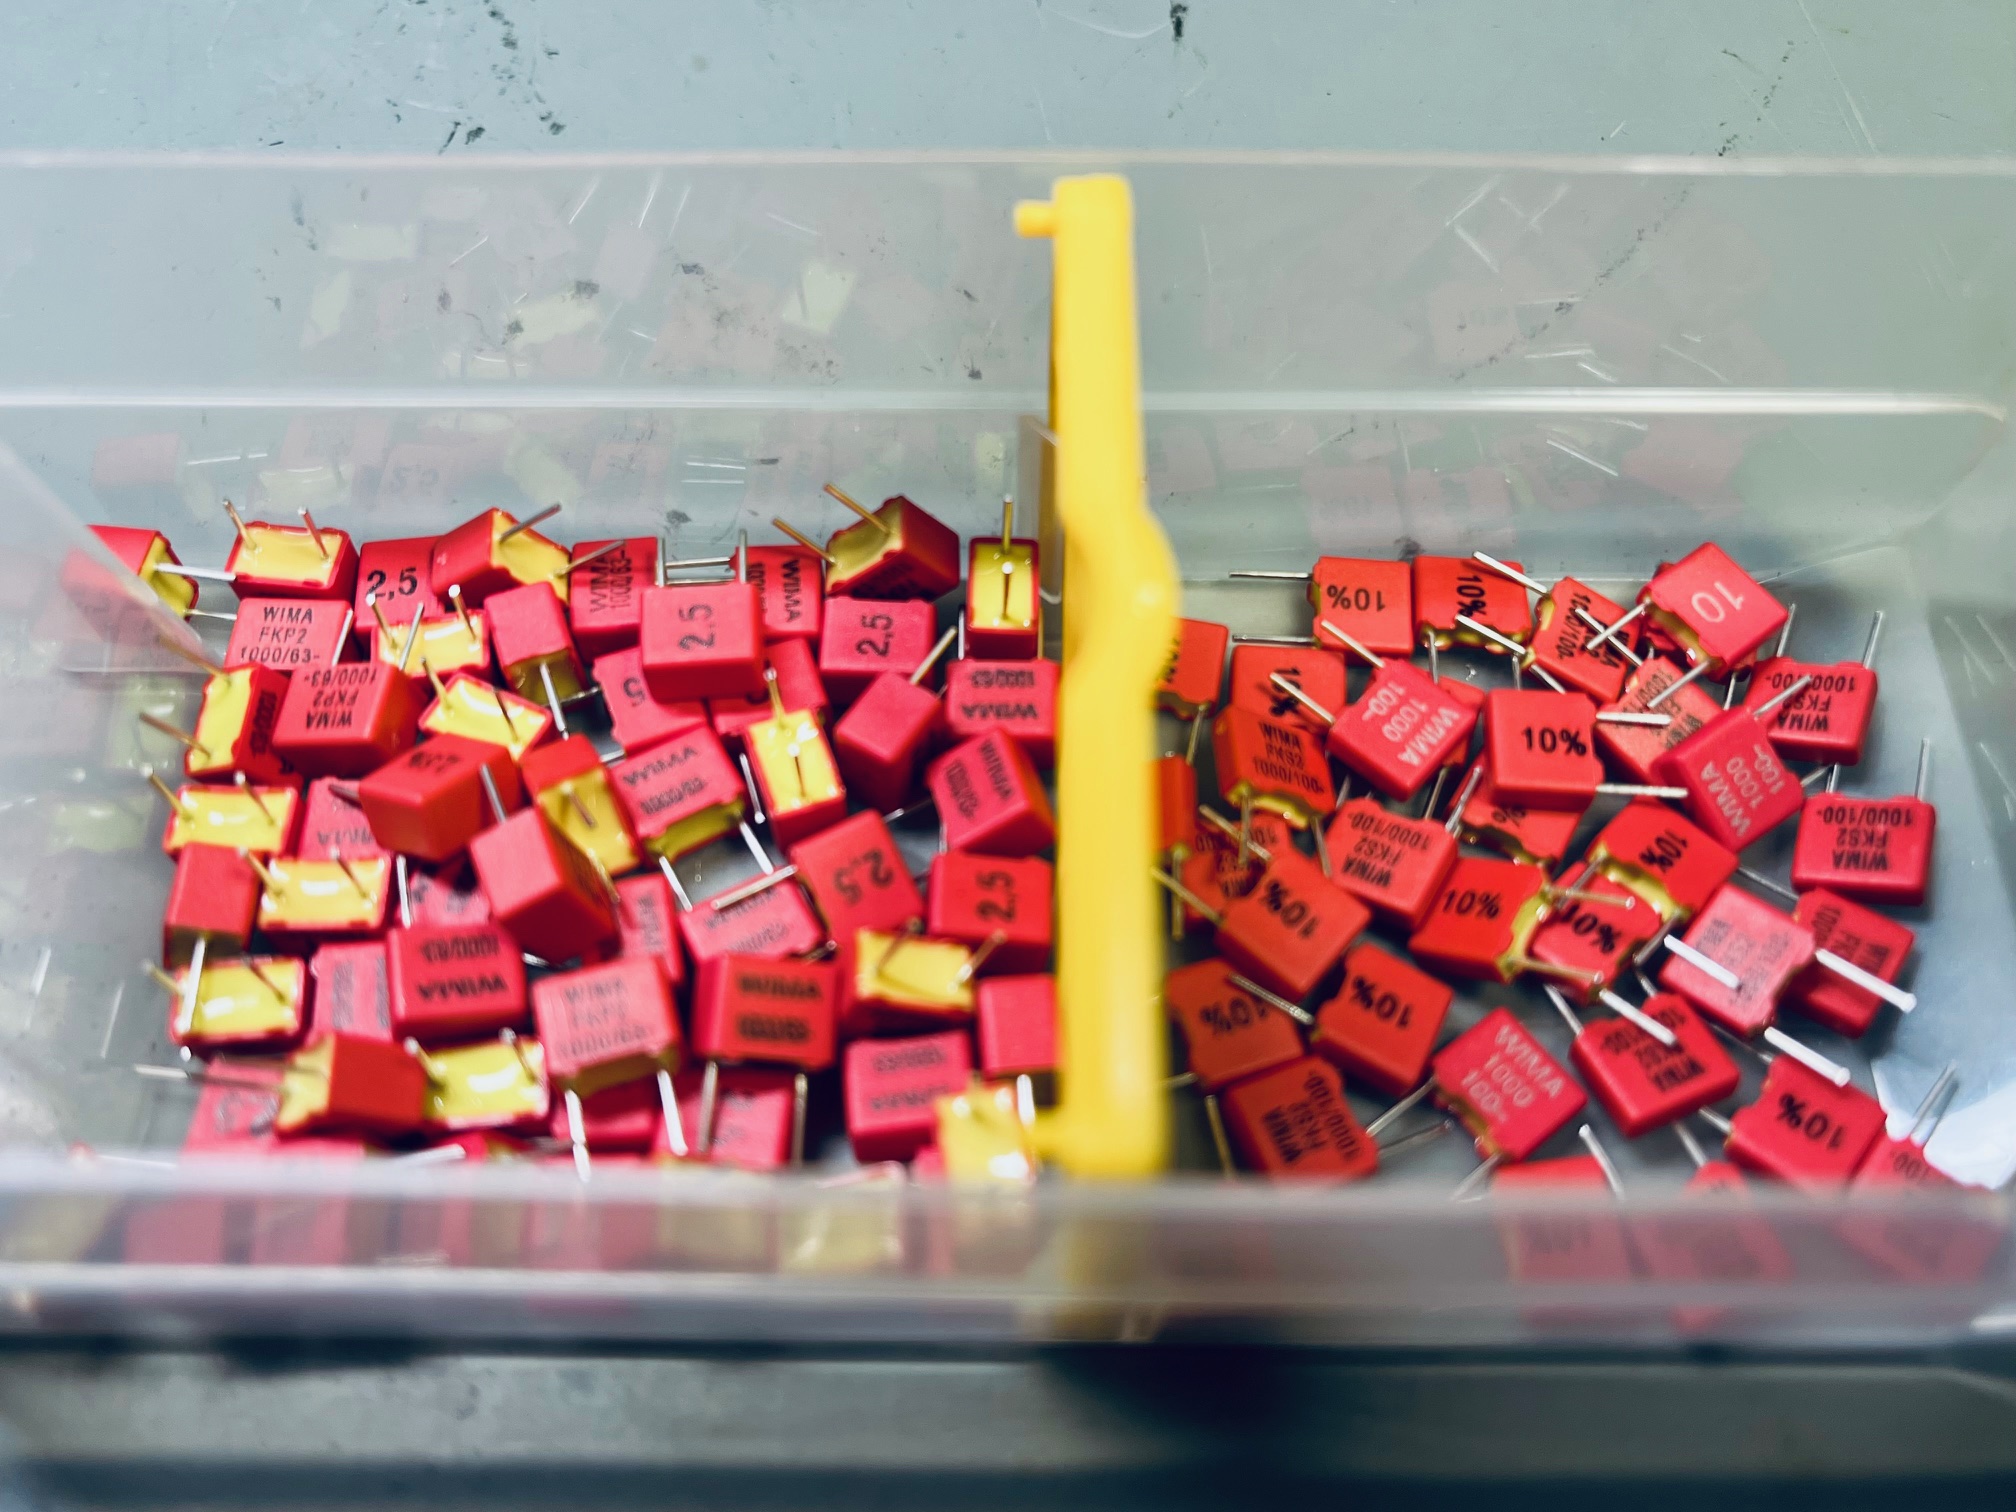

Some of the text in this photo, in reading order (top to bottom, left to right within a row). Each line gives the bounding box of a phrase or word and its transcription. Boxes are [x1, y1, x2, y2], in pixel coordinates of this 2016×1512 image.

[366, 567, 418, 599] 2,5
[781, 559, 801, 623] WIMA
[1327, 585, 1386, 612] 10%
[1456, 575, 1487, 617] 10%
[263, 607, 313, 623] WIMA
[1691, 580, 1746, 623] 10
[259, 628, 307, 644] FKP2
[241, 647, 321, 664] 1000/63-
[304, 668, 378, 684] 1000/63-
[312, 690, 359, 707] FKP2
[306, 711, 353, 729] WIMA
[1382, 698, 1429, 742] 1000
[1777, 711, 1829, 731] WIMA
[1397, 707, 1461, 766] WIMA
[1522, 727, 1587, 756] 10%
[1726, 757, 1764, 808] 1000
[1700, 761, 1750, 838] WIMA
[1816, 806, 1913, 826] 1000/100-
[1354, 836, 1404, 866] FKS2
[1639, 829, 1688, 874] 10%
[1836, 828, 1888, 847] FKS2
[1343, 856, 1392, 888] WIMA
[1832, 849, 1889, 870] WIMA
[1264, 881, 1318, 938] 10%
[1442, 889, 1502, 920] 10%
[1559, 904, 1621, 954] 10%
[1202, 997, 1270, 1038] 10%
[1353, 975, 1411, 1029] 10%
[1494, 1024, 1565, 1098] WIMA
[1484, 1052, 1535, 1108] 1000
[1777, 1093, 1845, 1150] 10%
